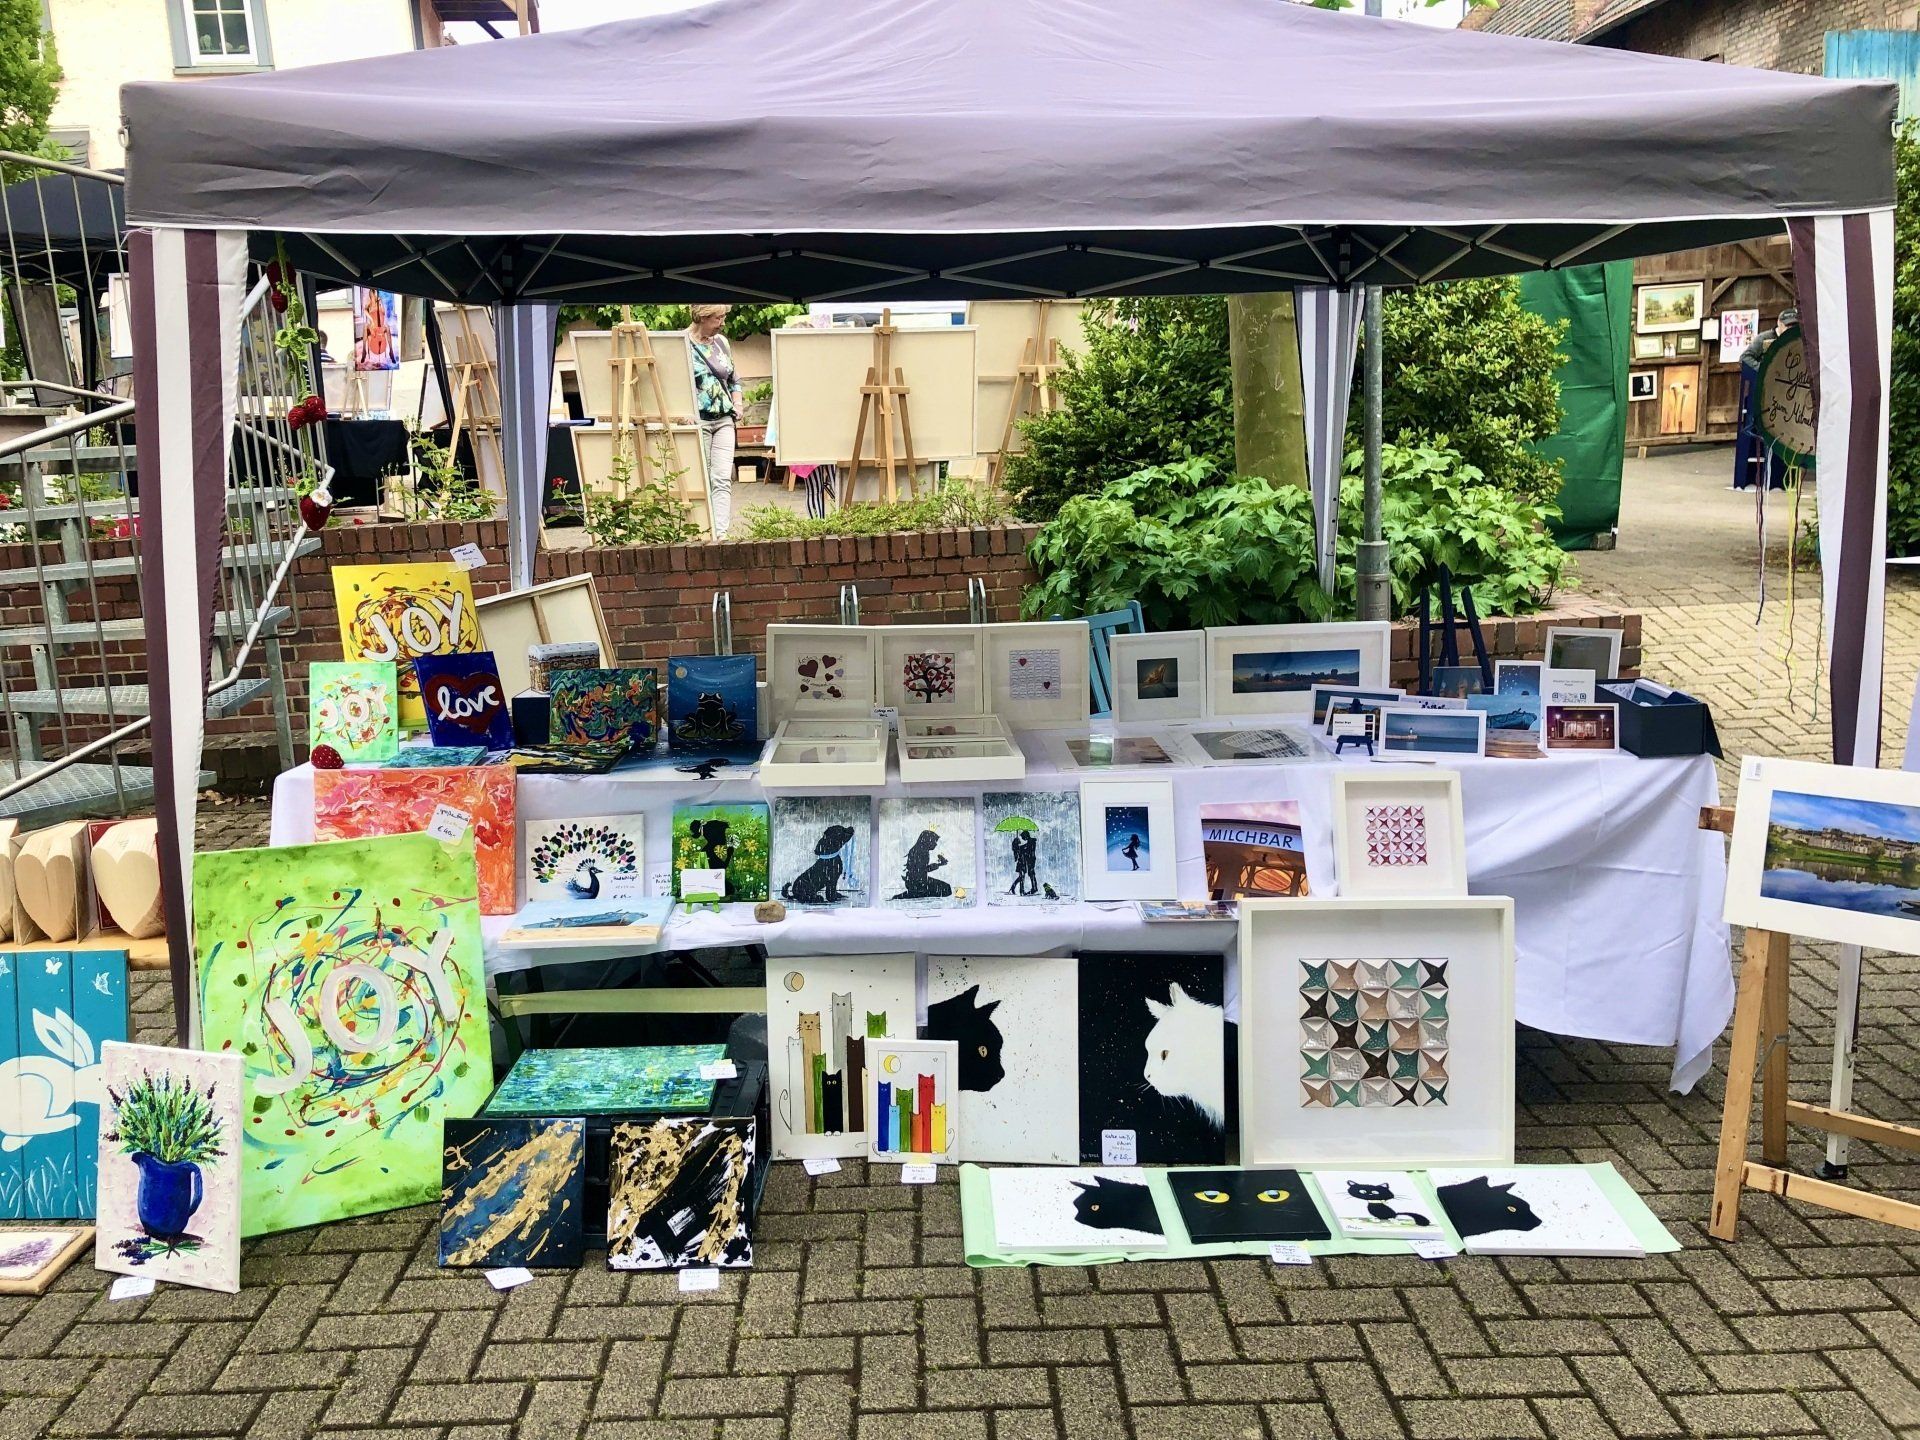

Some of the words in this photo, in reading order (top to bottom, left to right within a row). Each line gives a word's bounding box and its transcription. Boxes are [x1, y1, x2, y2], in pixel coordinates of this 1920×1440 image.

[1724, 314, 1733, 325] K
[1723, 336, 1742, 347] ST
[362, 591, 464, 662] JOY
[318, 683, 388, 729] JOY
[437, 685, 500, 721] love
[1209, 829, 1293, 848] MILCHBAR
[253, 928, 459, 1095] JOY
